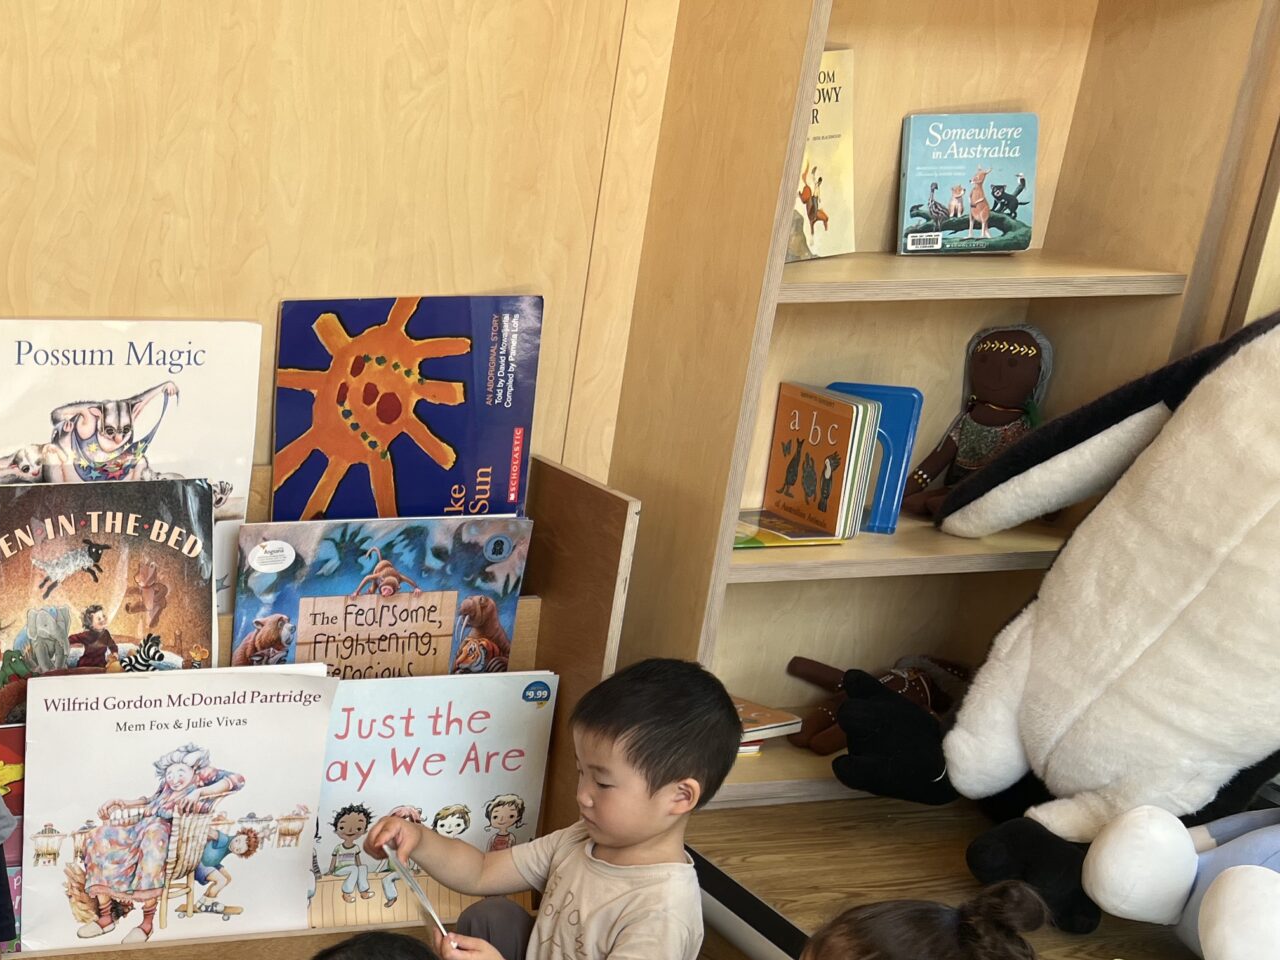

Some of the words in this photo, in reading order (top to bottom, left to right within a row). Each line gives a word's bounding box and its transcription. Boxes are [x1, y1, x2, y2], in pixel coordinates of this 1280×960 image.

[817, 70, 835, 84] OM
[814, 86, 842, 105] OWY
[926, 122, 1022, 147] Somewhere
[932, 149, 942, 159] in
[944, 140, 1021, 159] Australia
[490, 313, 499, 341] STORY
[511, 313, 519, 331] Lofts
[14, 340, 114, 366] Possum
[124, 341, 206, 374] Magic
[508, 333, 517, 361] Pamela
[487, 343, 497, 392] ABORIGINAL
[497, 355, 506, 376] David
[507, 362, 516, 371] by
[494, 388, 503, 404] Told
[496, 377, 505, 387] by
[504, 373, 515, 407] Compiled
[486, 394, 492, 405] AN
[509, 427, 522, 492] SCHOLASTIC
[444, 484, 466, 515] ke
[469, 466, 493, 514] Sun
[44, 513, 76, 540] IN
[86, 511, 142, 537] THE
[149, 519, 204, 558] BED
[310, 612, 338, 626] The
[344, 604, 442, 632] Fearsome,
[313, 630, 437, 661] Frightening,
[44, 697, 99, 712] Wilfrid
[103, 695, 163, 711] Gordon
[167, 691, 247, 707] McDonald
[249, 690, 322, 706] Partridge
[115, 721, 146, 732] Mem
[150, 720, 170, 731] Fox
[173, 719, 183, 729] &
[185, 718, 213, 731] Julie
[216, 716, 248, 728] Vivas
[334, 707, 415, 740] Just
[428, 701, 491, 736] the
[326, 759, 376, 792] ay
[391, 747, 446, 776] We
[459, 742, 525, 775] Are
